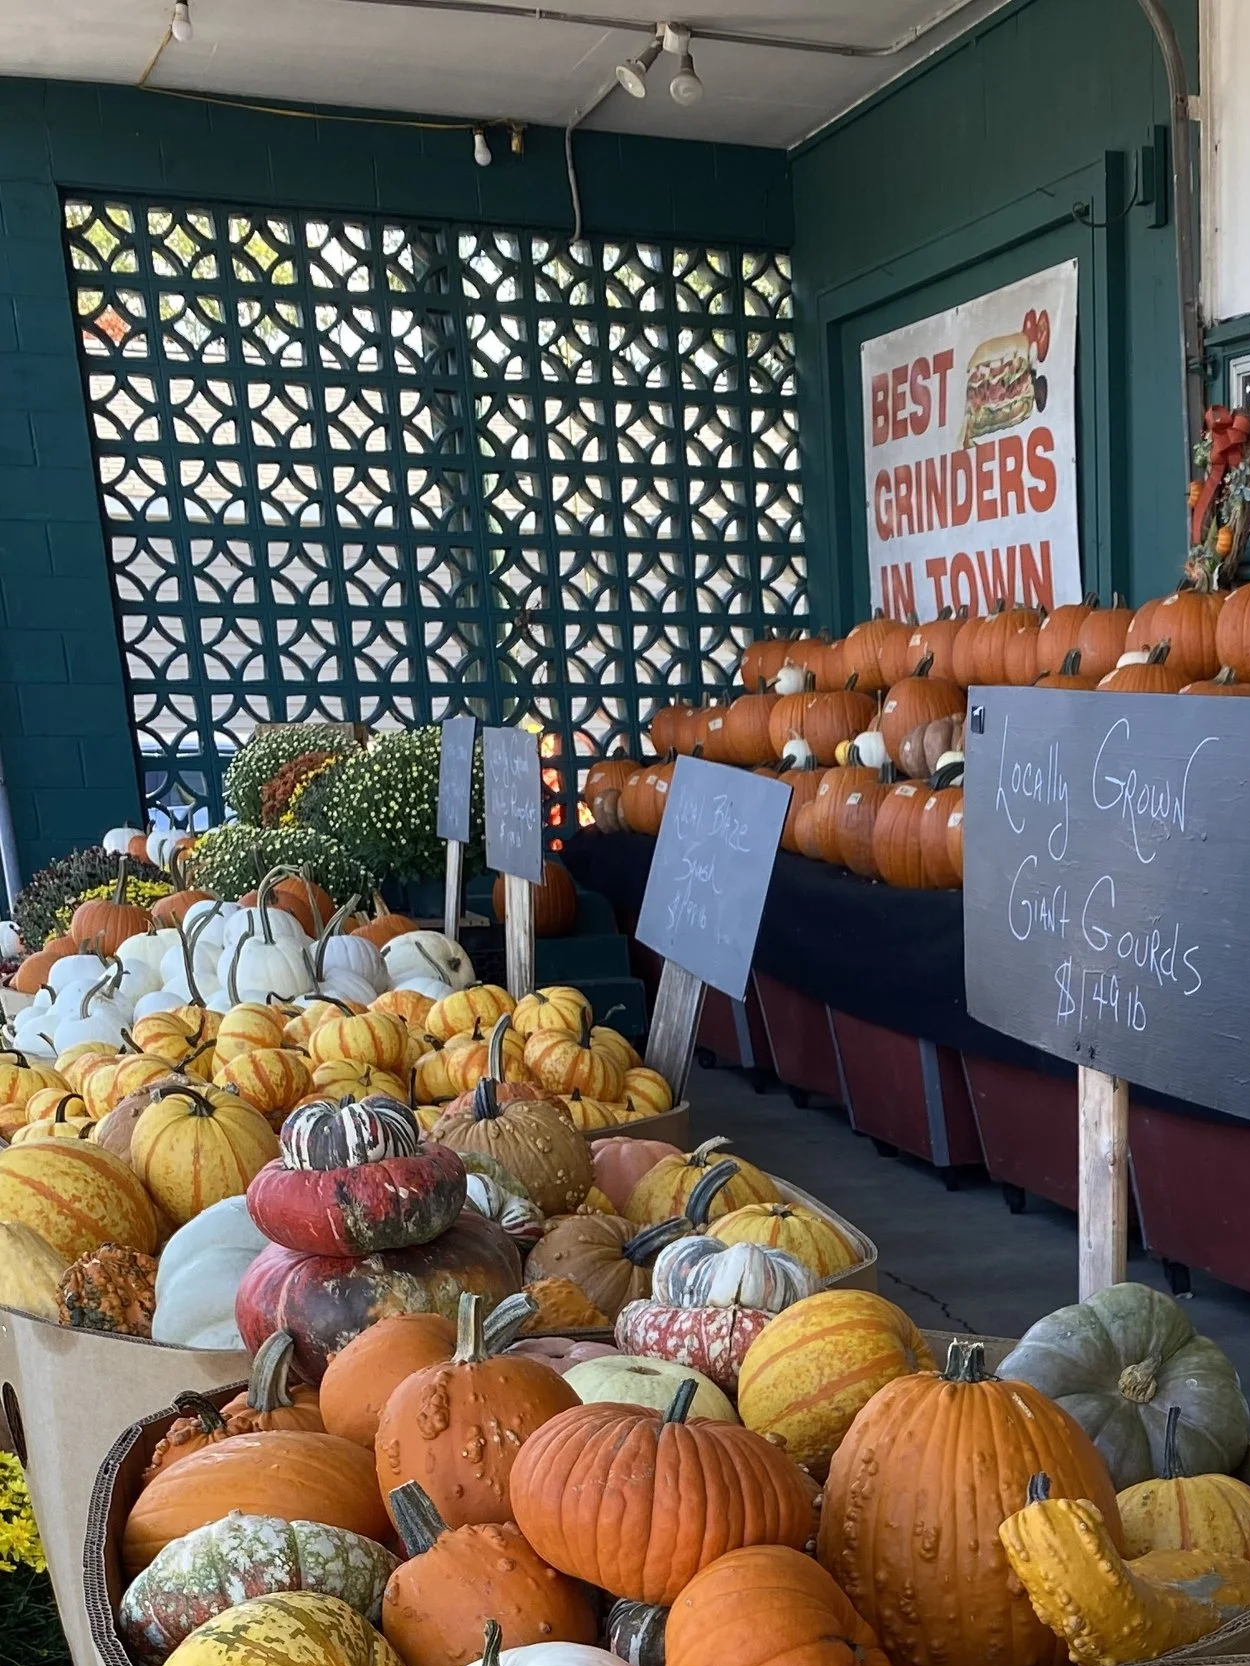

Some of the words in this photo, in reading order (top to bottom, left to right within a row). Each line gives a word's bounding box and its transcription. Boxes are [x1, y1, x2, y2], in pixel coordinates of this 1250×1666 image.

[871, 348, 954, 447] BEST
[874, 426, 1057, 542] GRINDERS
[881, 562, 918, 622] IN
[926, 540, 1053, 619] TOWN
[1127, 984, 1147, 1031] lb
